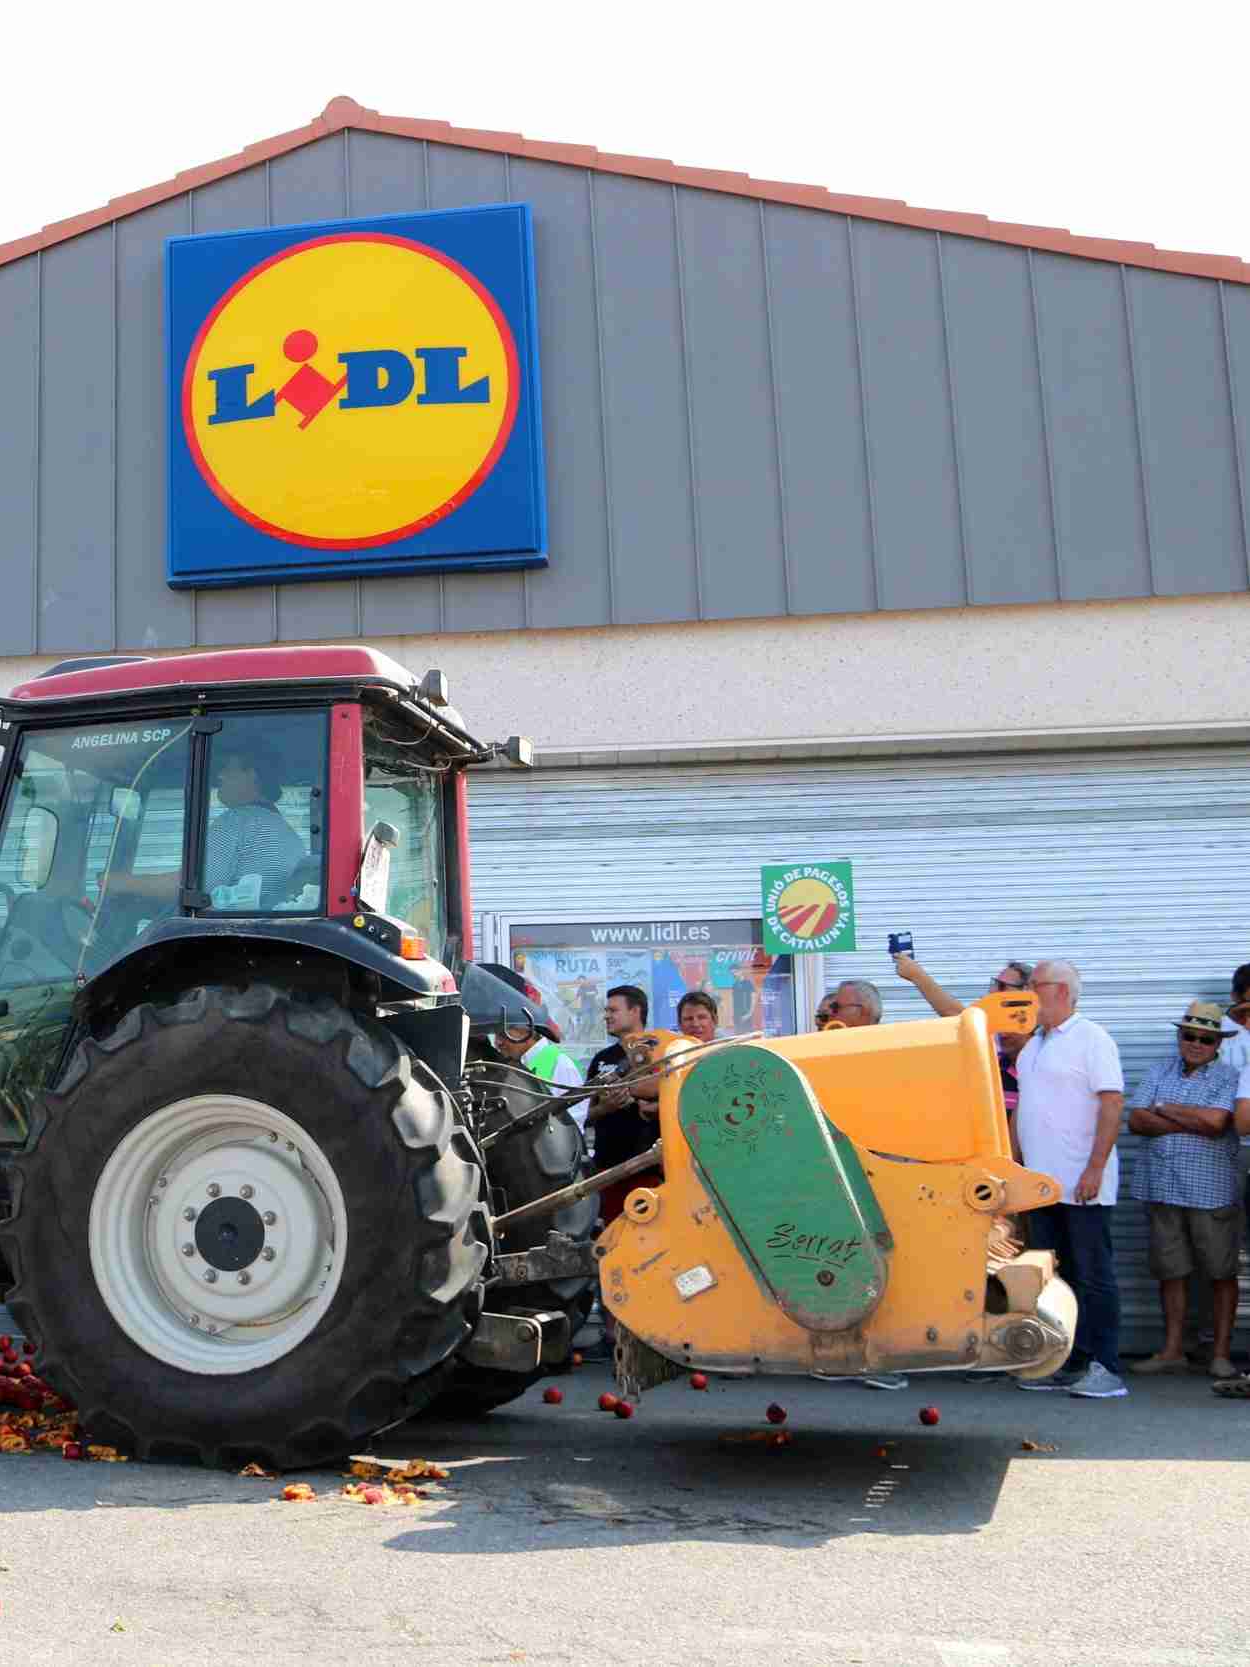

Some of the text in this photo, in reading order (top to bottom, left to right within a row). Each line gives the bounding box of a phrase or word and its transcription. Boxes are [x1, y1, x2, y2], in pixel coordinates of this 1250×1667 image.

[71, 728, 171, 749] ANGELINA SCP
[783, 868, 802, 881] DE
[803, 867, 850, 908] PAGESOS
[591, 922, 711, 943] www.lidl.es
[767, 911, 850, 950] DE CATALUNYA
[716, 947, 759, 963] crivit
[556, 958, 600, 974] RUTA
[765, 1223, 862, 1262] Serrat
